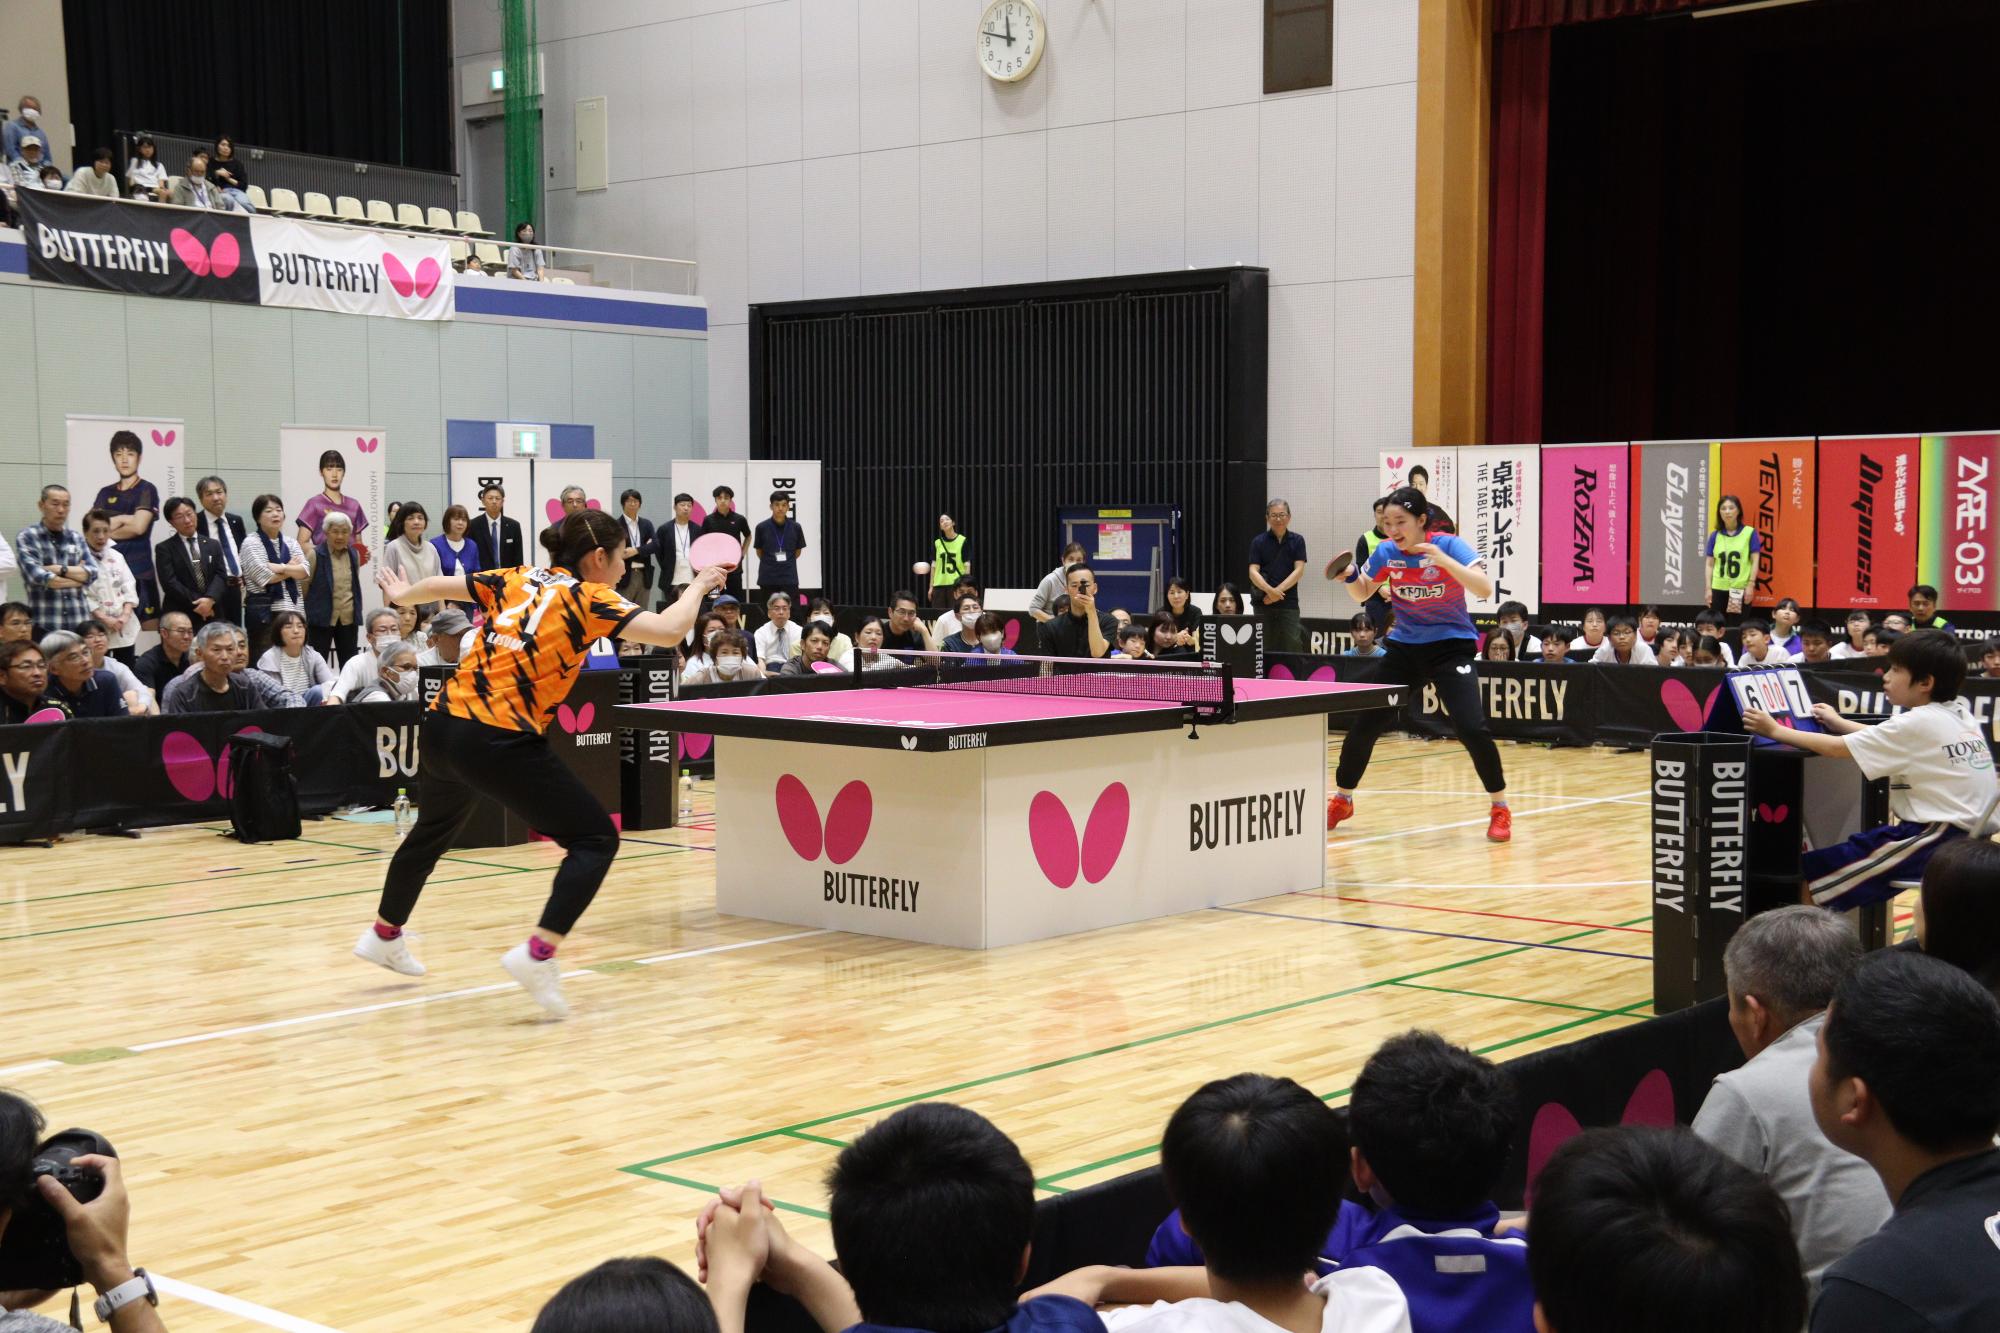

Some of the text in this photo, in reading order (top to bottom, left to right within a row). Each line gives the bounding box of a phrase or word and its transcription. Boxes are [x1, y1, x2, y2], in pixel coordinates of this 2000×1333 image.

[987, 21, 995, 33] 10
[996, 9, 1002, 21] 11
[1025, 15, 1031, 27] 2
[985, 36, 991, 47] 9
[1024, 44, 1031, 55] 4
[1028, 29, 1034, 41] 3
[987, 50, 994, 61] 8
[996, 59, 1002, 71] 7
[1006, 62, 1012, 73] 6
[1016, 56, 1023, 68] 5
[38, 222, 169, 275] BUTTERFLY
[268, 252, 379, 294] BUTTERFLY
[1478, 462, 1488, 483] THE
[369, 470, 379, 524] HARIMOTO
[1477, 486, 1488, 519] TABLE
[1491, 460, 1514, 604] 卓球レポート
[1573, 464, 1597, 586] ROZENA
[1660, 462, 1689, 589] GLAYZER
[1755, 452, 1780, 595] TENERGY
[370, 526, 379, 552] MIWA
[940, 552, 957, 575] 15
[1717, 550, 1741, 579] 16
[1203, 623, 1217, 661] BUTTE
[1422, 677, 1568, 721] BTERFLY
[1745, 684, 1763, 711] 6
[1788, 680, 1806, 714] 7
[576, 732, 612, 747] BUTTERFLY
[948, 731, 988, 750] BUTTERFLY
[1190, 788, 1306, 852] BUTTERFLY
[1654, 759, 1686, 913] BUTTERFLY
[1709, 761, 1746, 913] BUTTERFLY
[823, 870, 920, 913] BUTTERFLY
